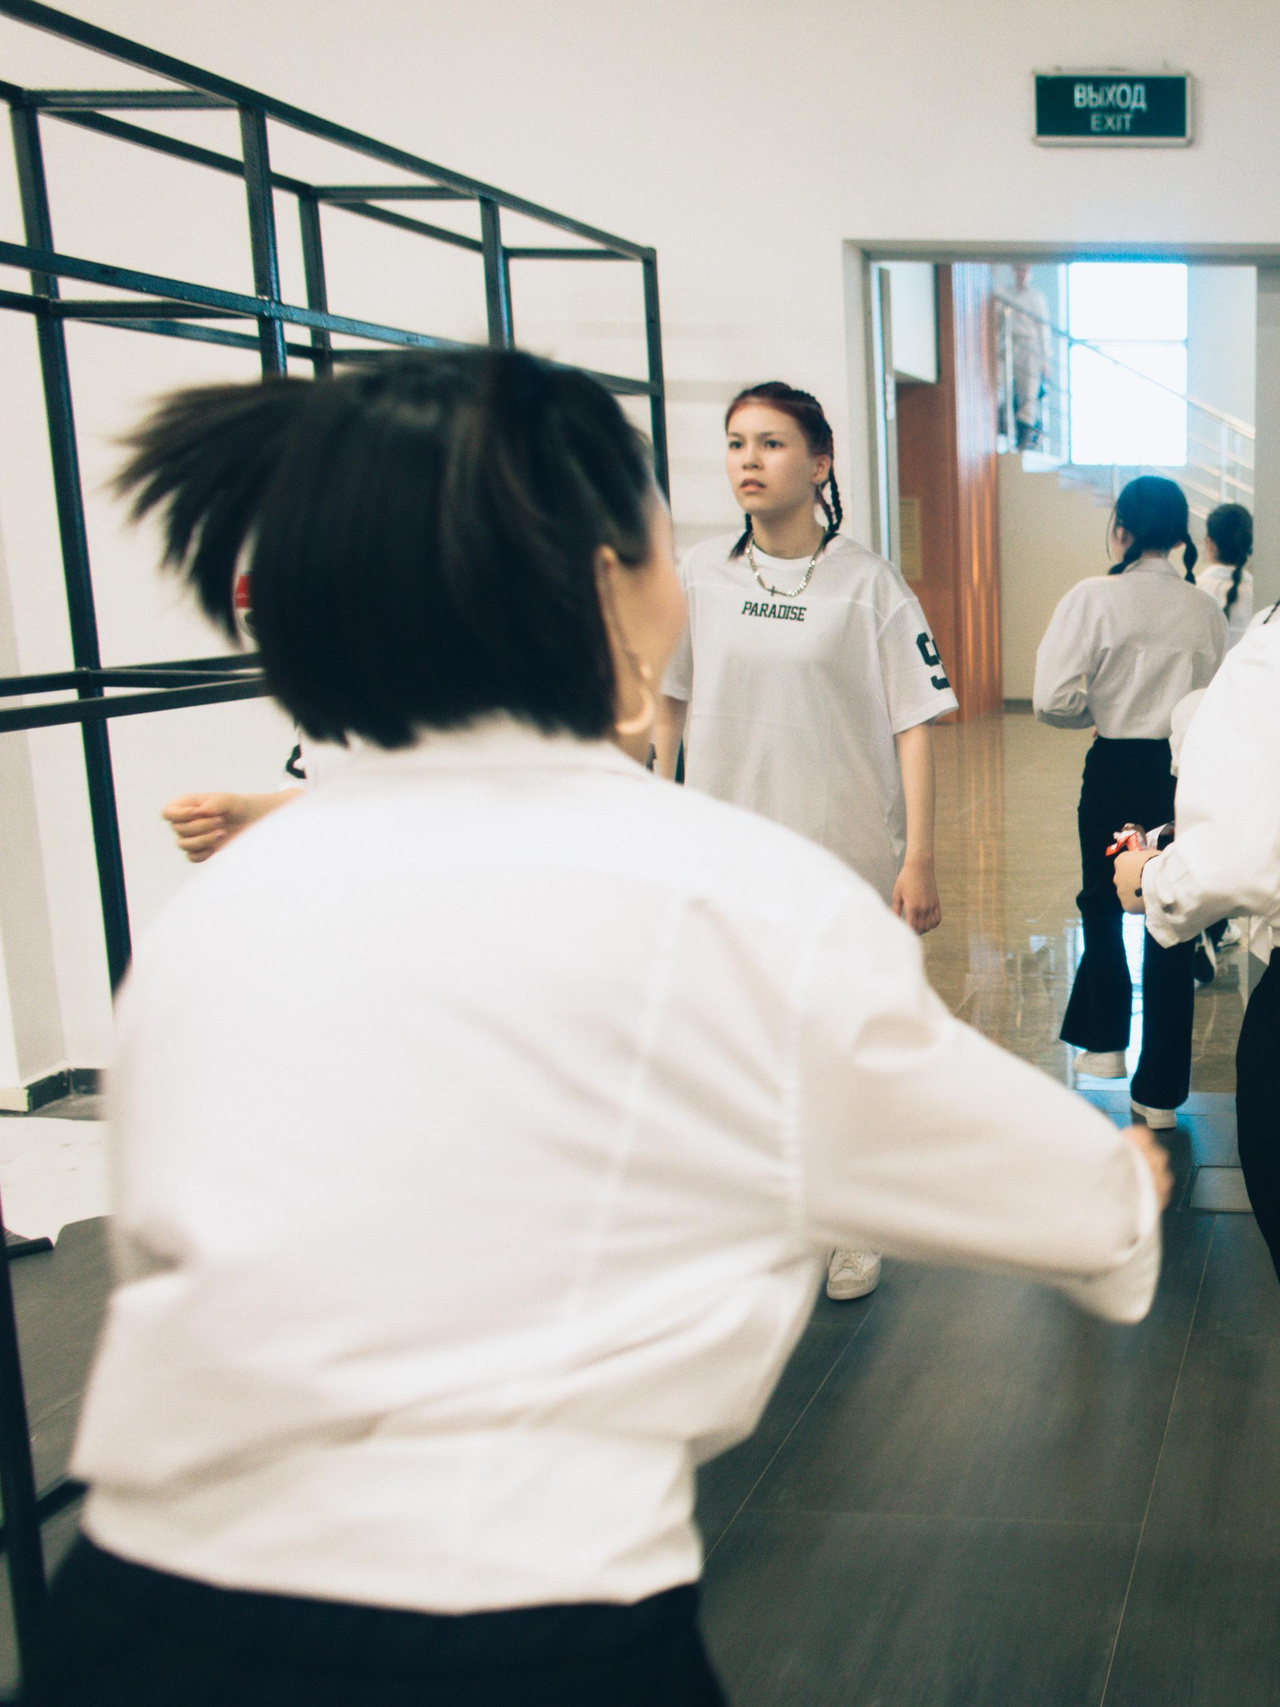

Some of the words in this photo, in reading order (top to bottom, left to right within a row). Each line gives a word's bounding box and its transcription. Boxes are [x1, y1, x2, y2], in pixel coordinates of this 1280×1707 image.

[1073, 83, 1147, 112] ВЫХОД
[1090, 113, 1133, 131] EXIT
[741, 601, 807, 621] PARADISE
